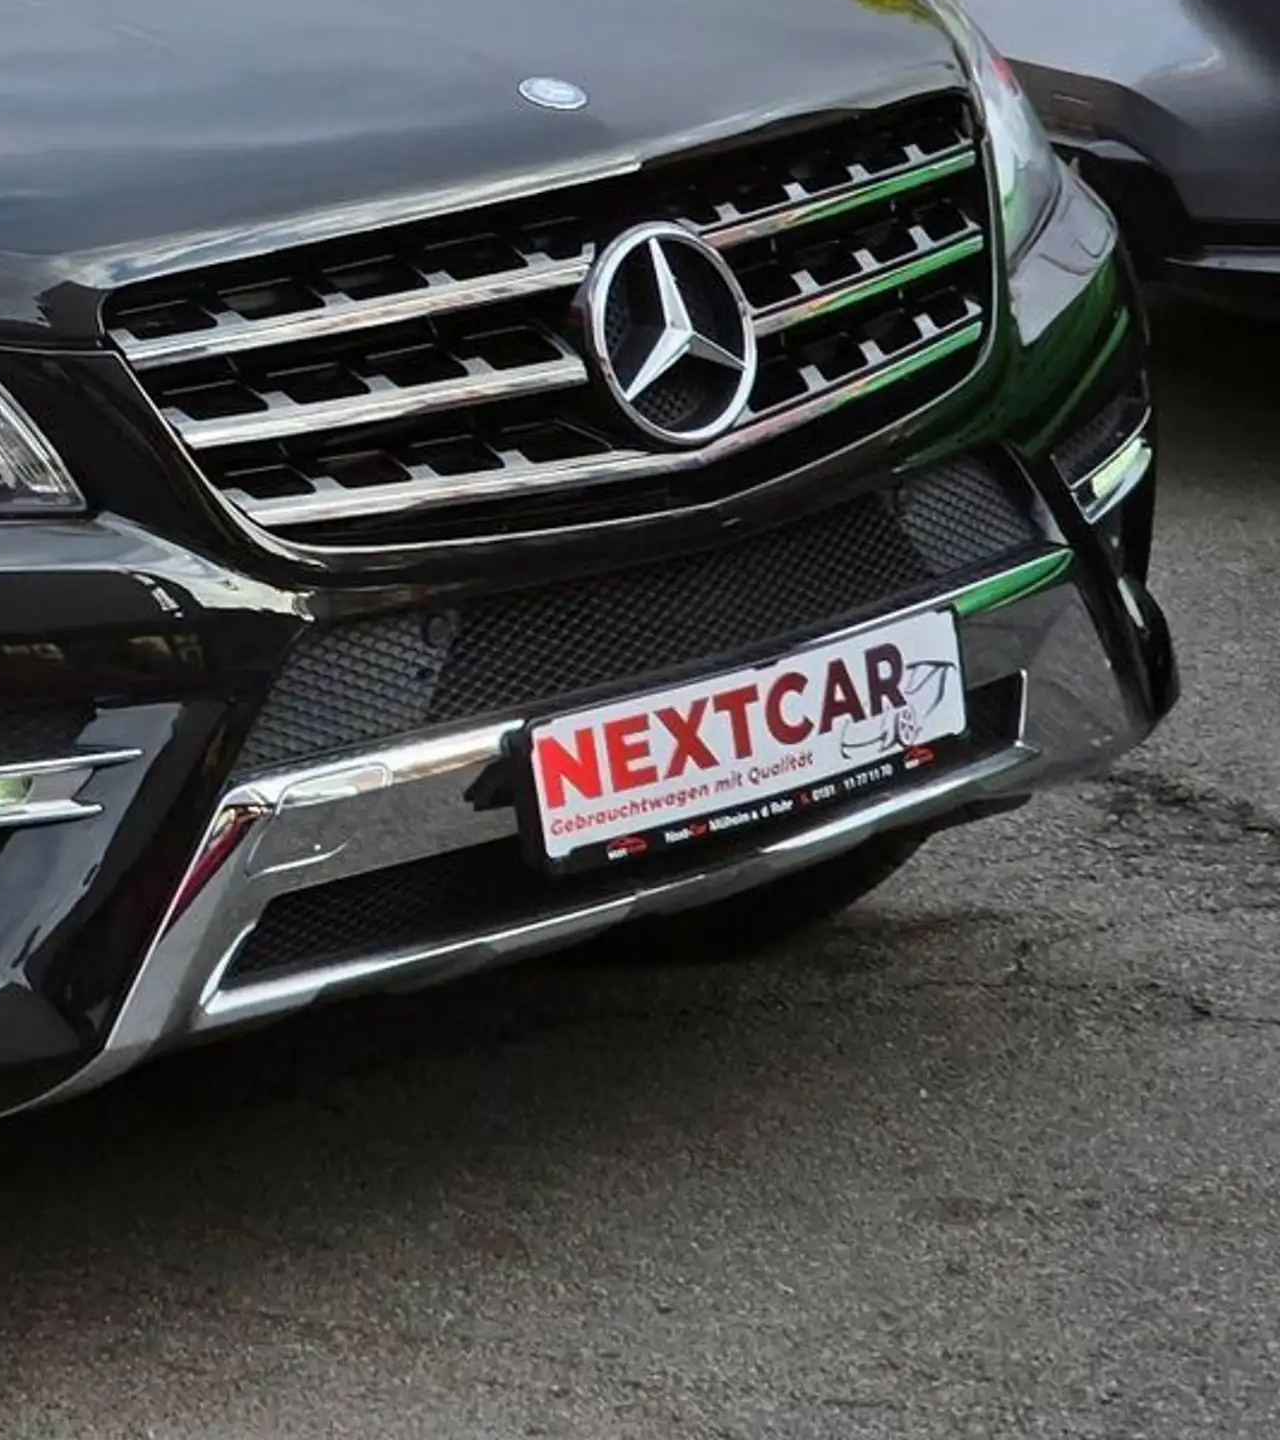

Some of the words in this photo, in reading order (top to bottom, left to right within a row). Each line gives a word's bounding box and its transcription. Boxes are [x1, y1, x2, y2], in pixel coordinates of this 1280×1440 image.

[534, 643, 909, 809] NEXTCAR
[550, 782, 709, 837] Gebrauchtwagen
[715, 771, 744, 793] mit
[748, 750, 814, 785] Qualität
